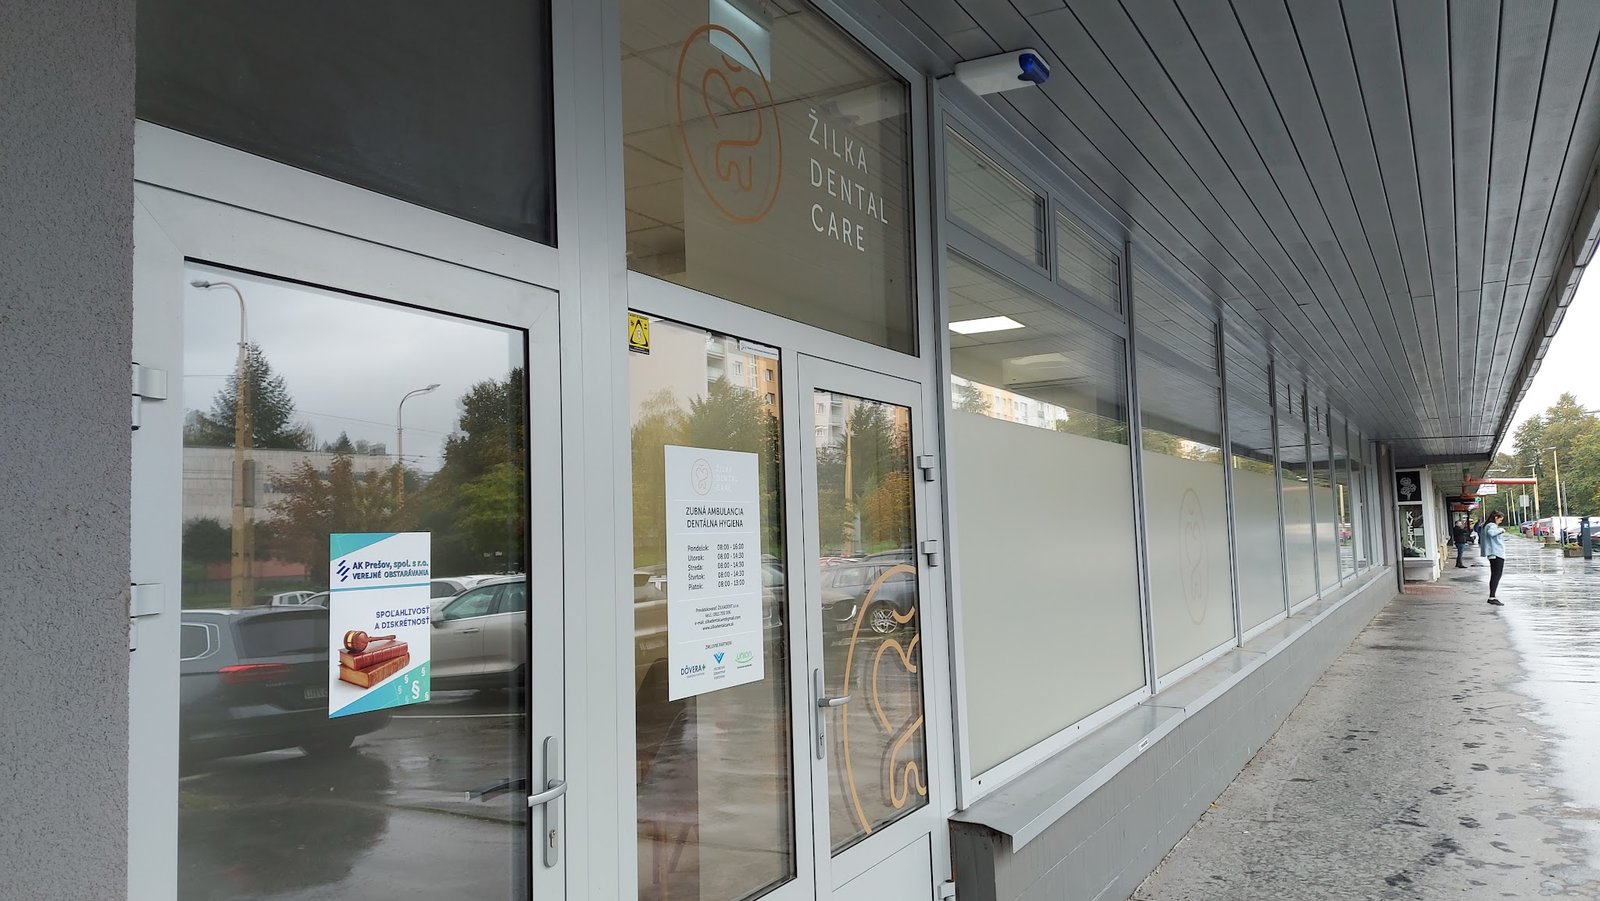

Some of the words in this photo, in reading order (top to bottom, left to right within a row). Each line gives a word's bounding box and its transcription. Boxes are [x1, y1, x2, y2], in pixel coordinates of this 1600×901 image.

[809, 108, 867, 174] ŽILKA
[811, 158, 888, 225] DENTAL
[811, 203, 864, 252] CARE
[686, 505, 706, 516] ZUBNÁ
[707, 507, 744, 516] AMBULANCIA
[686, 518, 718, 528] DENTÁLNA
[719, 519, 744, 528] HYGIENA
[1406, 511, 1414, 549] KVETY
[352, 561, 363, 570] AK
[365, 560, 392, 570] Prešov,
[393, 560, 411, 569] spol.
[352, 570, 381, 580] VEREJNÉ
[384, 569, 429, 578] OBSTARÁVANIA
[376, 607, 430, 619] SPOĽAHLIVOSŤ
[374, 622, 380, 630] A
[382, 617, 430, 629] DISKRÉTNOSŤ
